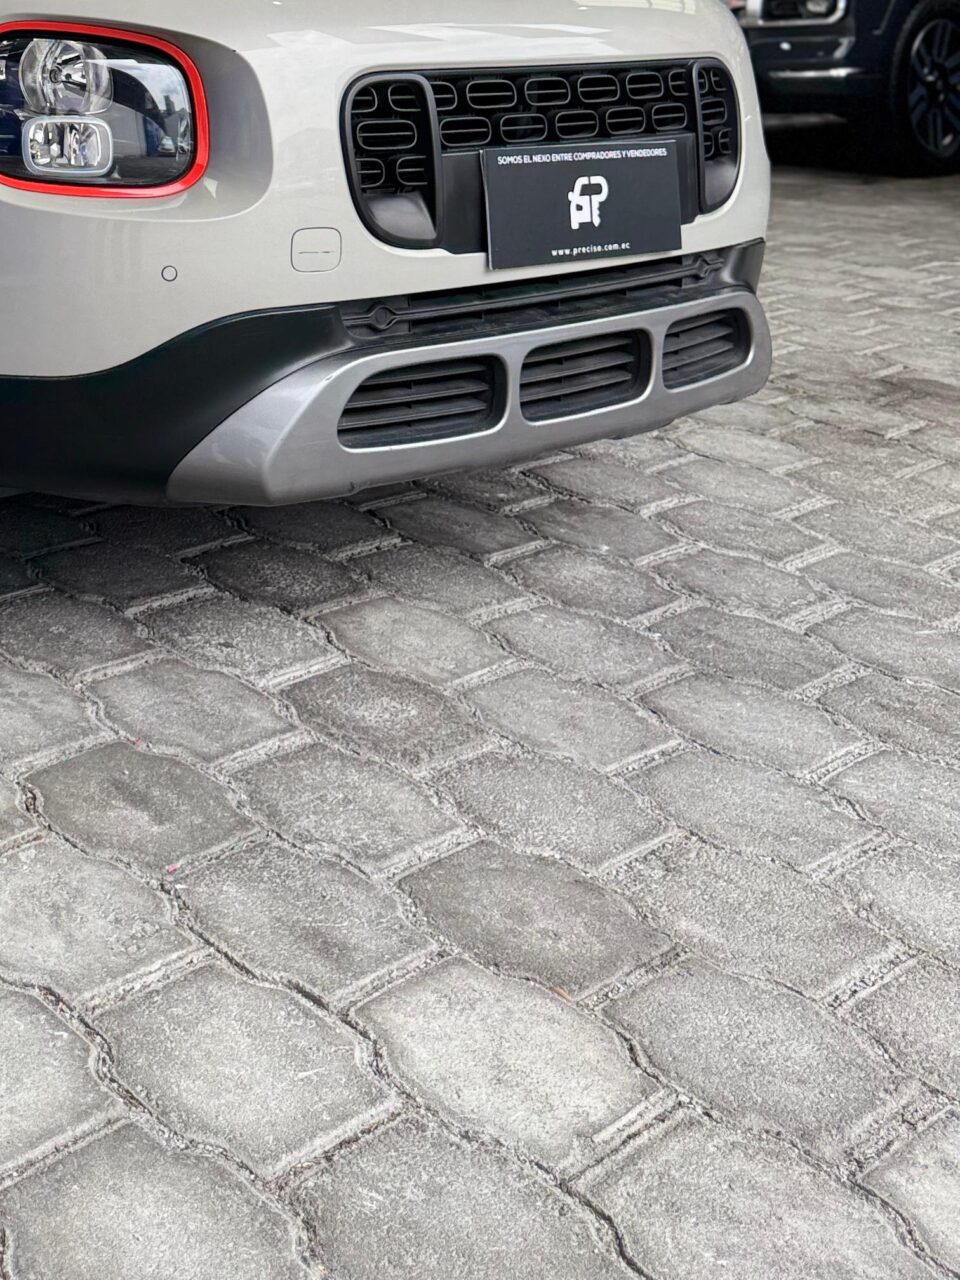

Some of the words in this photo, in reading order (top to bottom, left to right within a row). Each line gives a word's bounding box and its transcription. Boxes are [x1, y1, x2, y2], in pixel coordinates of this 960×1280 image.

[497, 155, 523, 165] SOMOS
[523, 154, 532, 164] EL
[532, 153, 551, 163] NEXO
[551, 152, 573, 162] ENTRE
[573, 150, 622, 161] COMPRADORES
[622, 150, 627, 158] Y
[627, 148, 668, 158] VENDEDORES
[551, 242, 631, 257] www.preciso.com.ec
